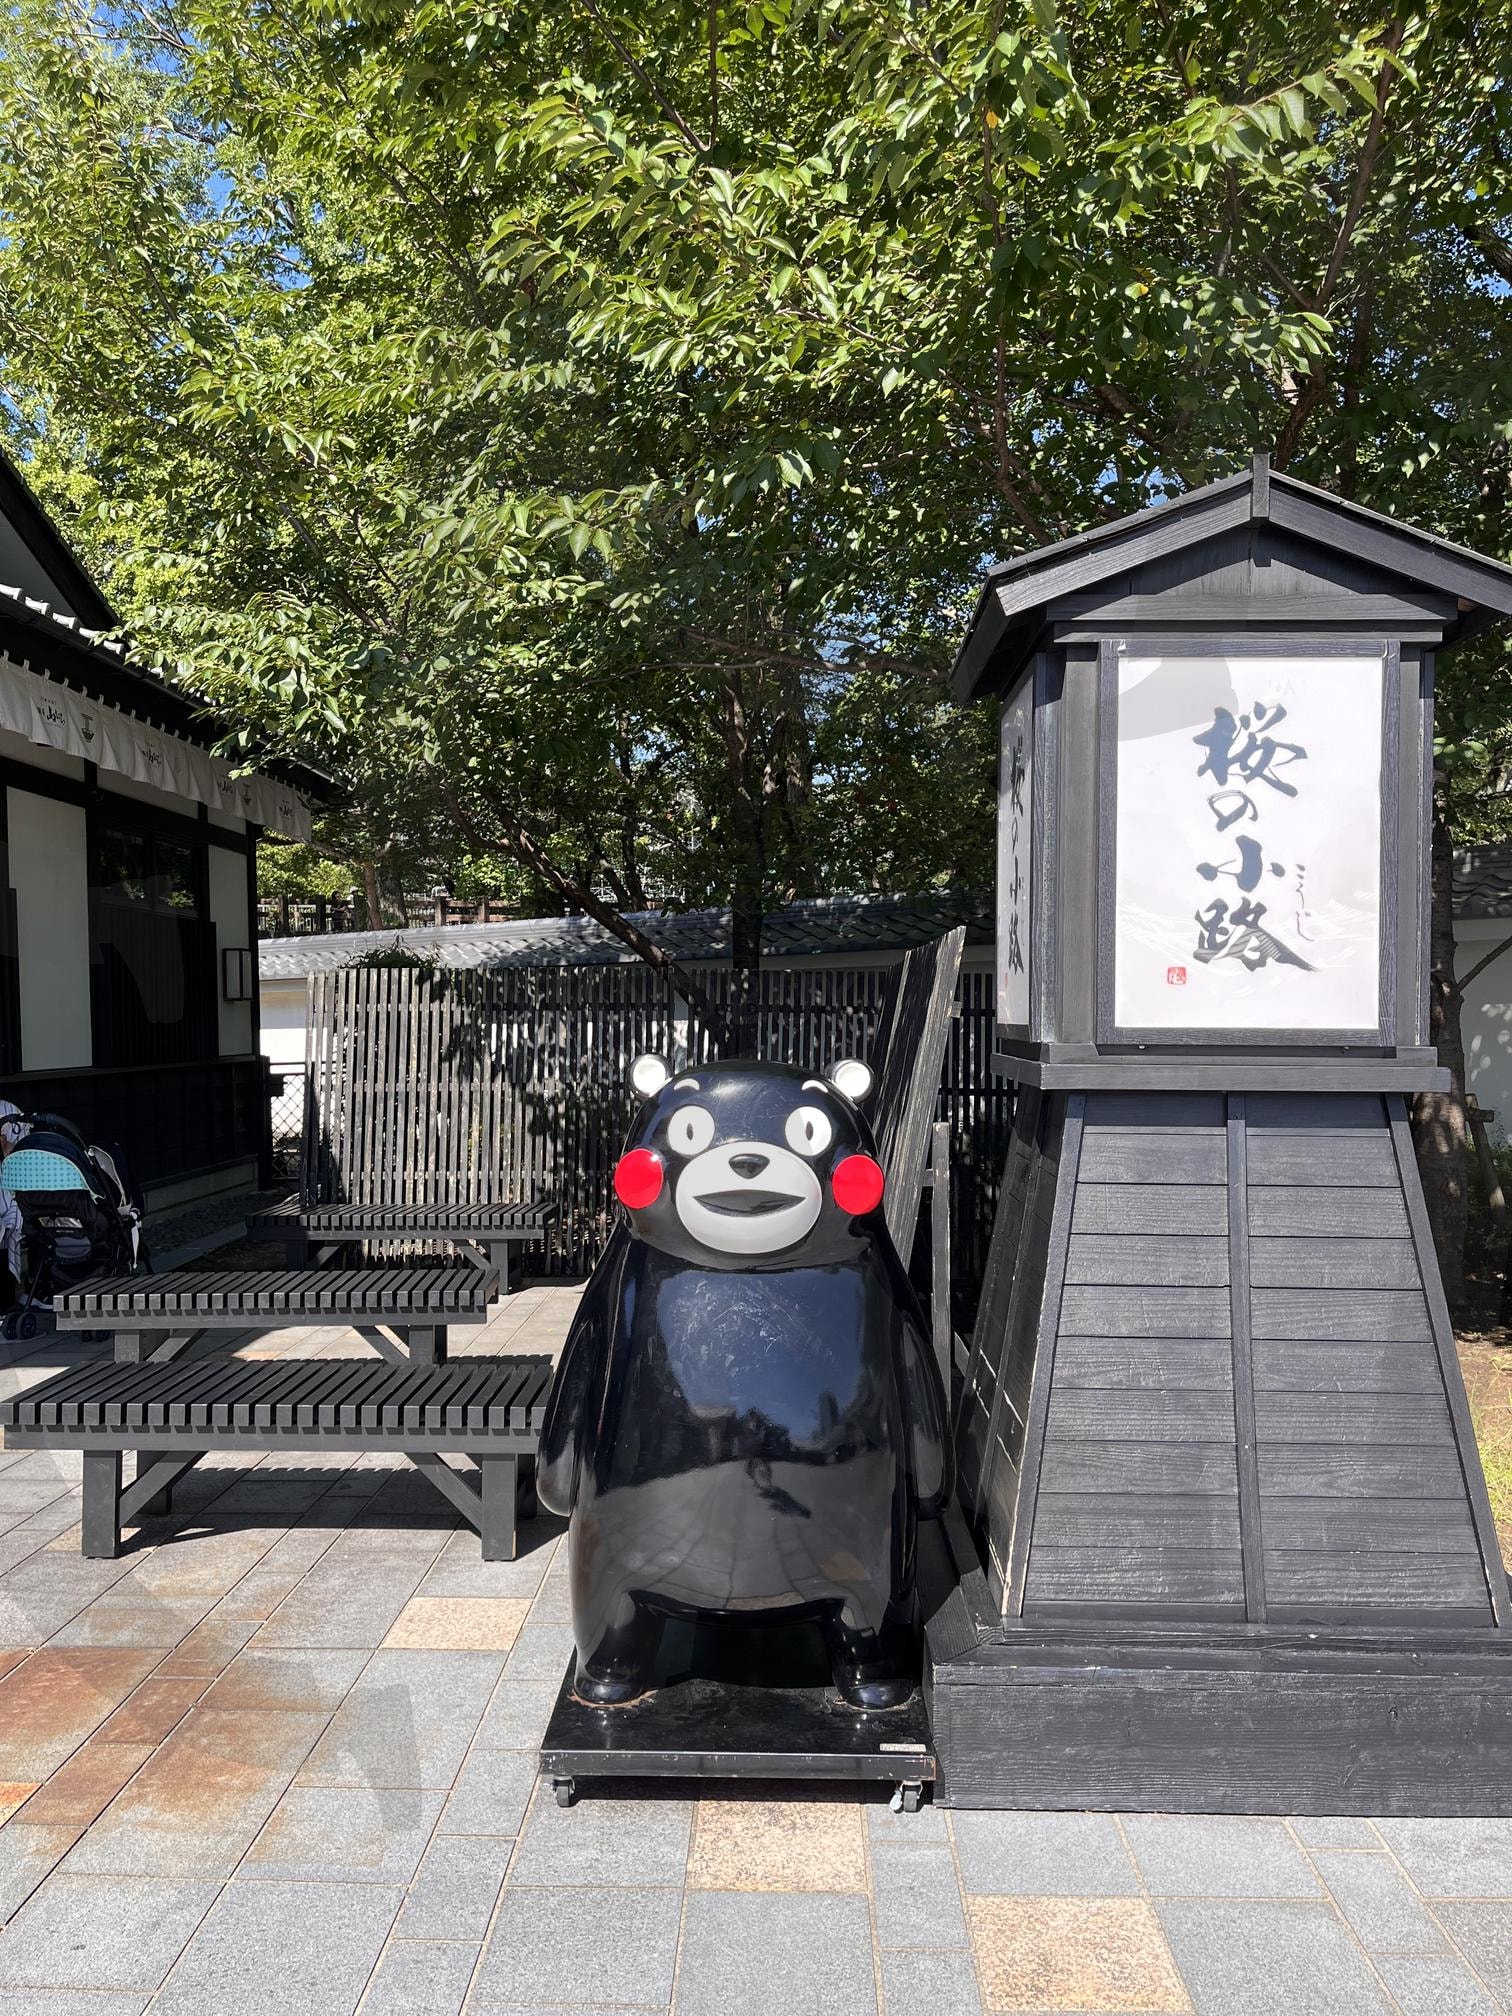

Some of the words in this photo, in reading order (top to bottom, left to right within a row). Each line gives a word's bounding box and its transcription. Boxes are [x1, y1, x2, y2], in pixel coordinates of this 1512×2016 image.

[1192, 701, 1319, 972] 桜の小路
[1295, 863, 1315, 942] こうじ
